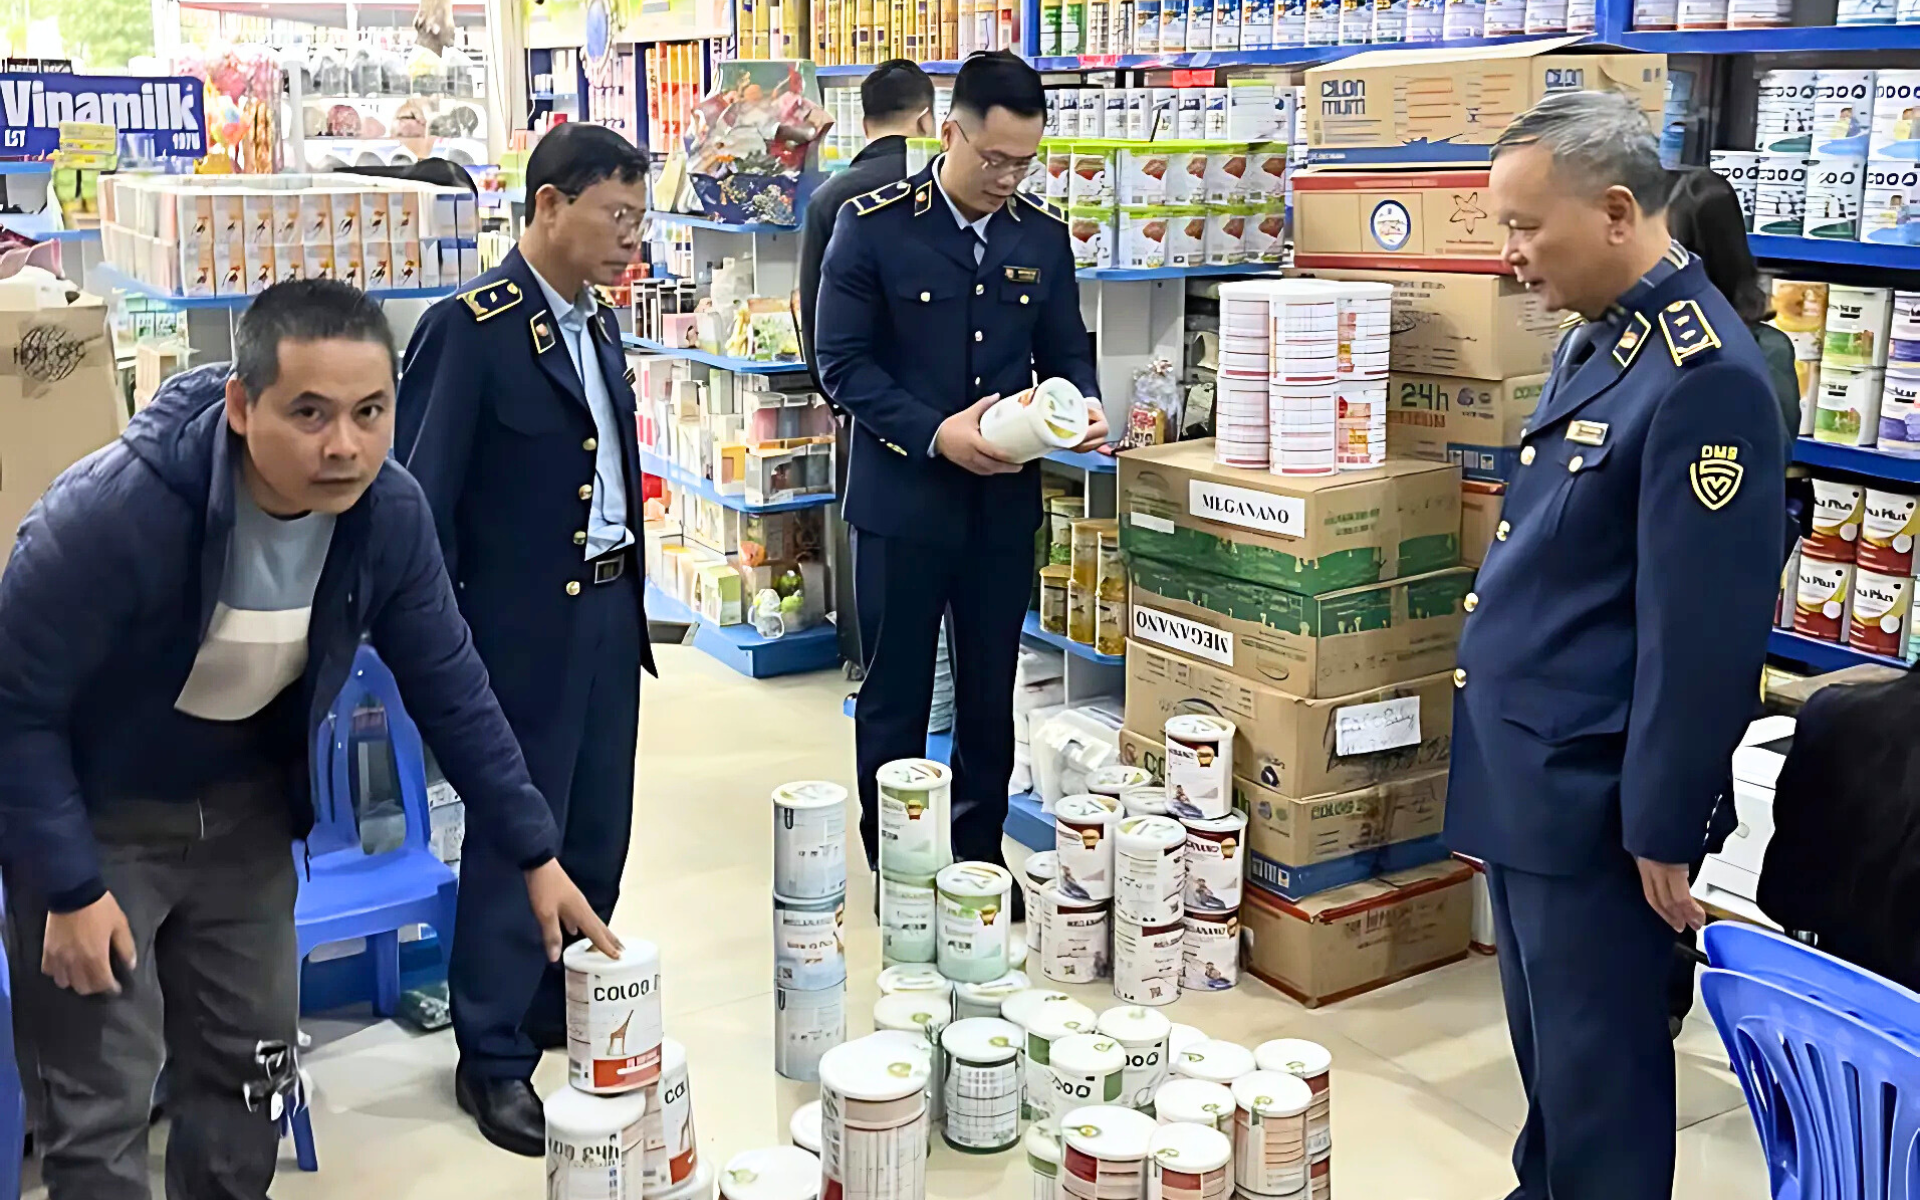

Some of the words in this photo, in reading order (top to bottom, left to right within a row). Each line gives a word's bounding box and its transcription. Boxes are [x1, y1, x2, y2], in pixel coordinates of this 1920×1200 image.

[0, 80, 199, 131] Vinamilk
[1401, 382, 1449, 411] 24h
[1203, 493, 1289, 524] MEGANANO
[1136, 611, 1228, 653] MEGANANO
